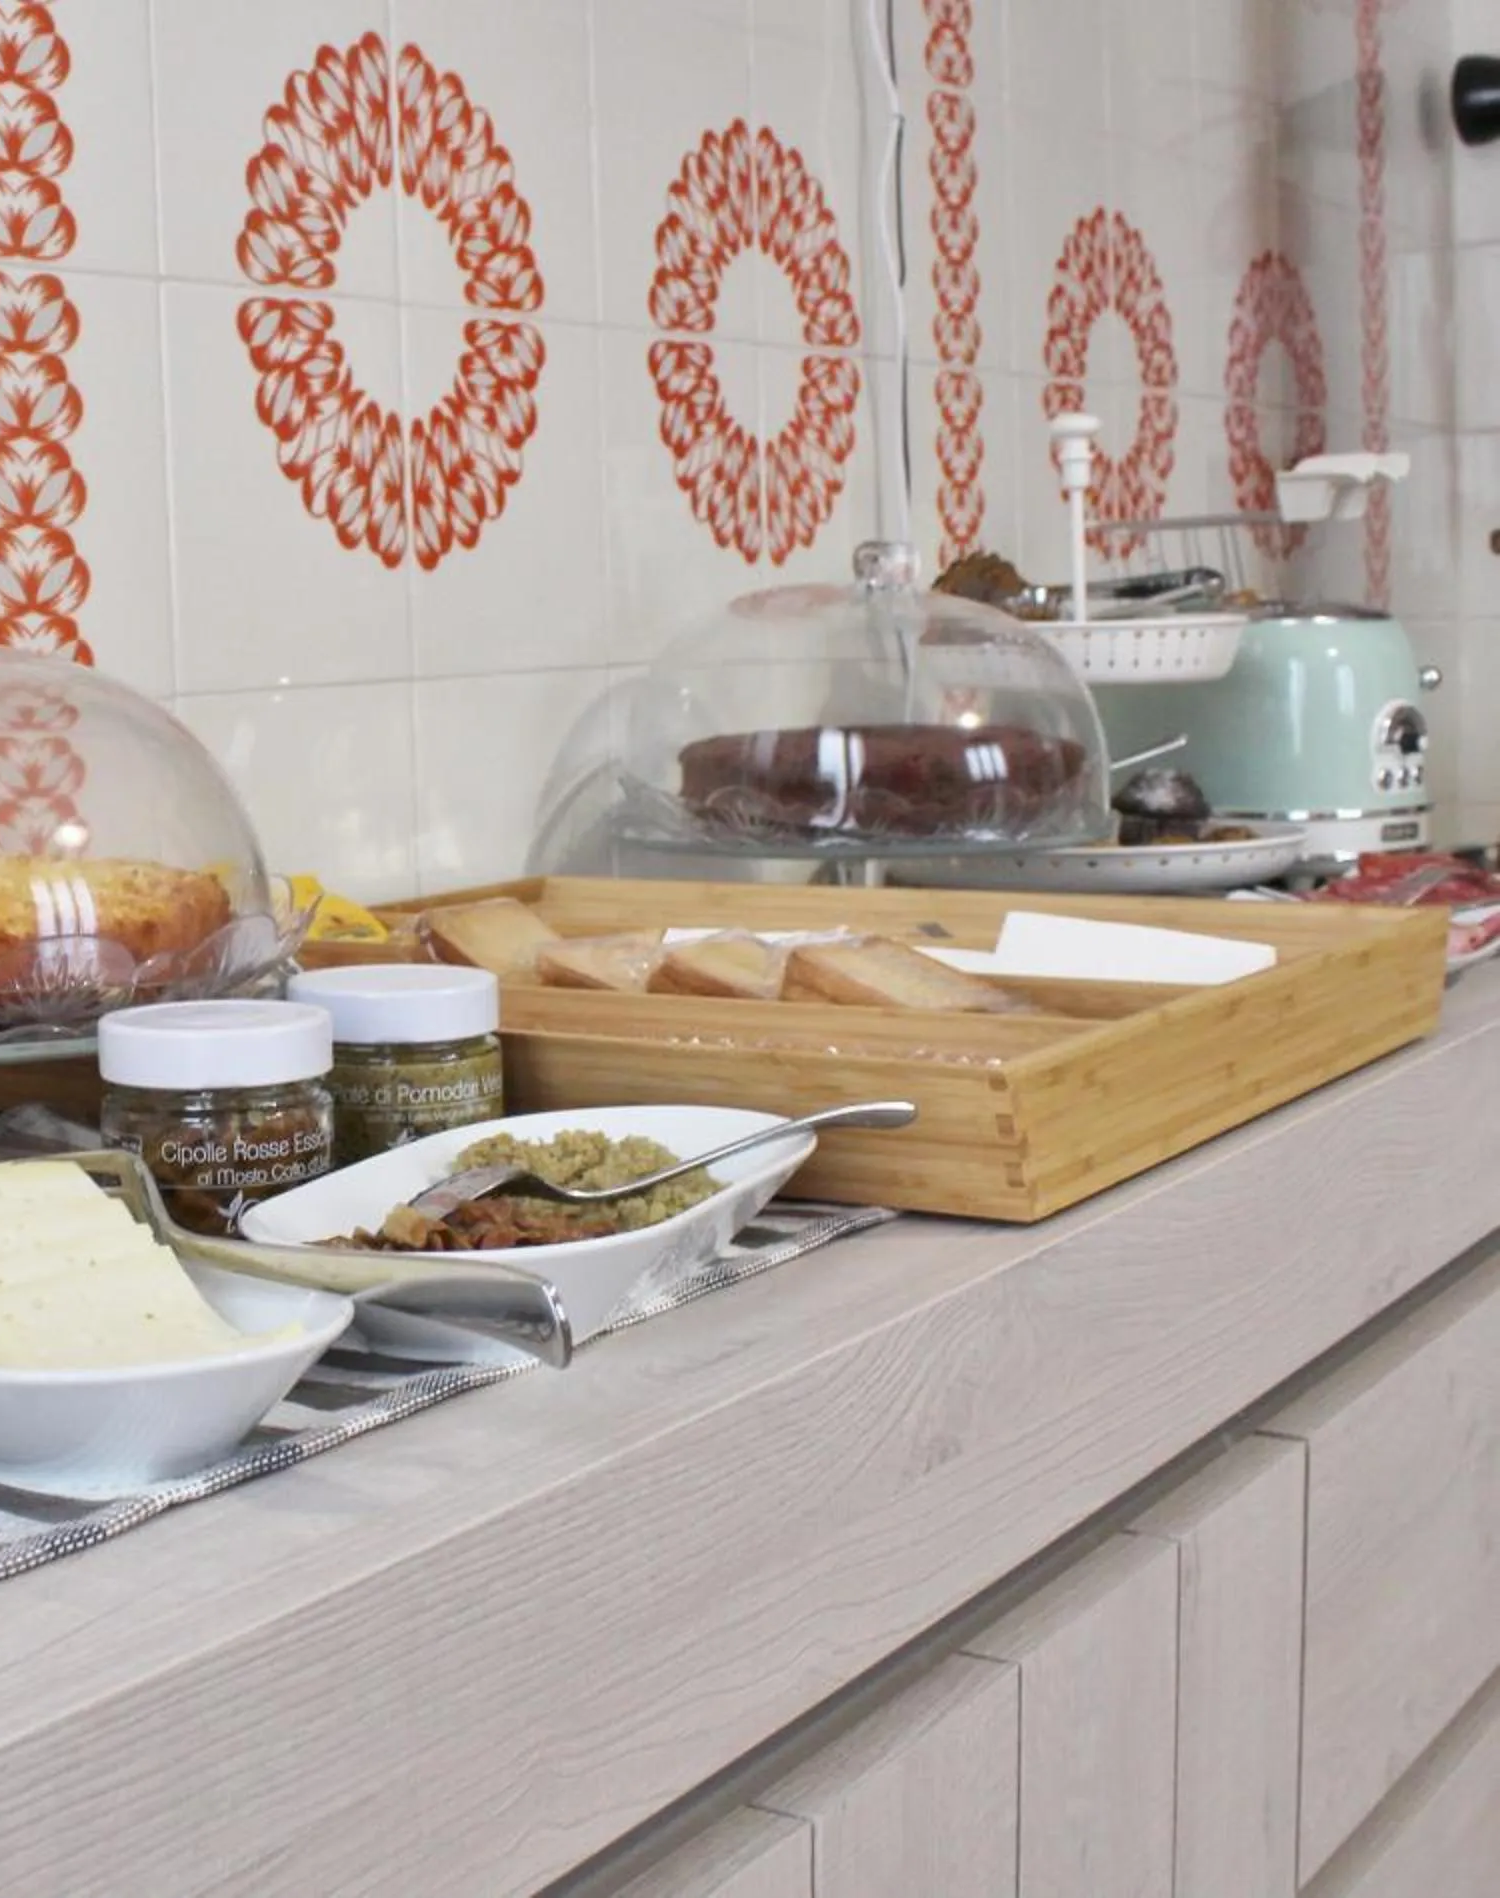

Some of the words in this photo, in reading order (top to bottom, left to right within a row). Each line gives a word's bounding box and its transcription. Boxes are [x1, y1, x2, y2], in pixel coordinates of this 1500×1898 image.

[160, 1138, 228, 1168] Cipolle
[232, 1137, 290, 1161] Rosse
[217, 1167, 269, 1186] Mosto
